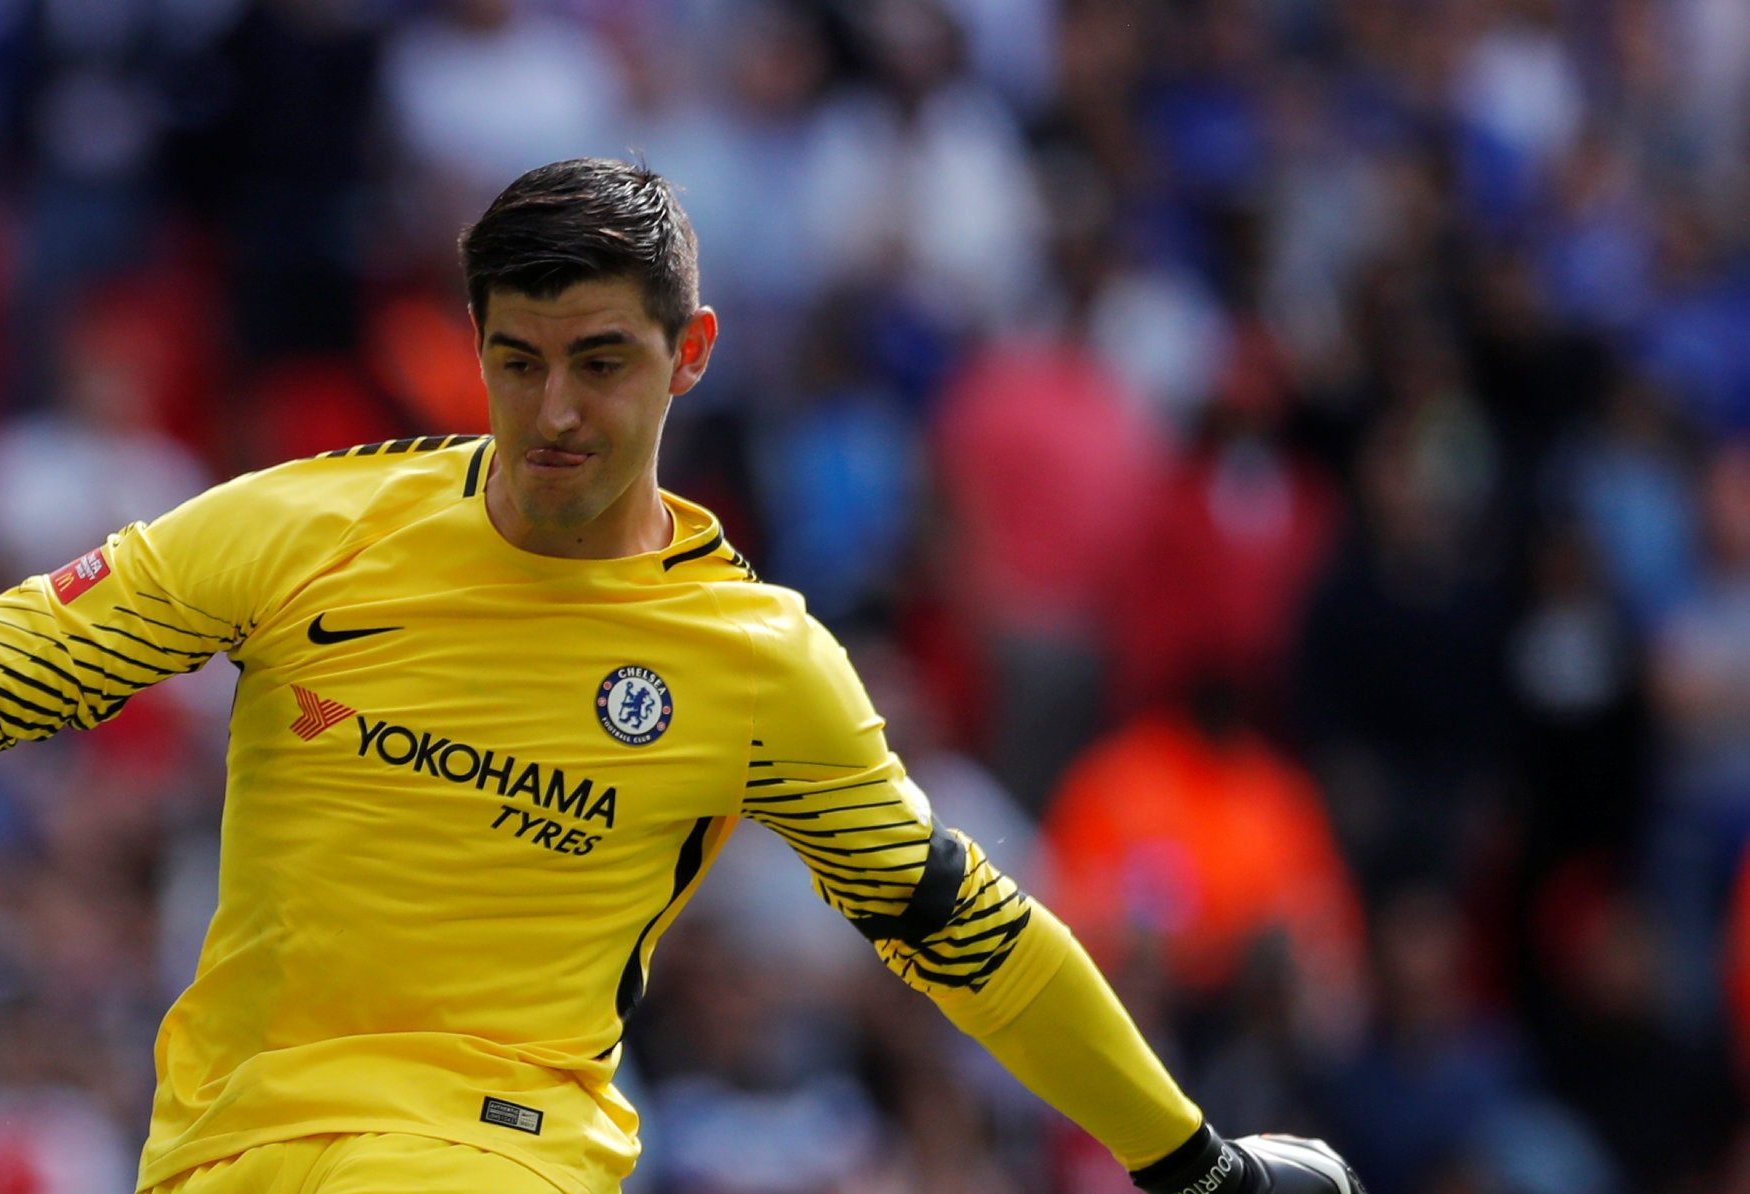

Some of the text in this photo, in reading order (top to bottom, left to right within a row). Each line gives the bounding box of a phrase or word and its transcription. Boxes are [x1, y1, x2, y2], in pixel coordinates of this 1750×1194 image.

[618, 667, 666, 696] CHELSEA
[357, 716, 618, 829] YOKOHAMA
[491, 805, 602, 857] TYRES
